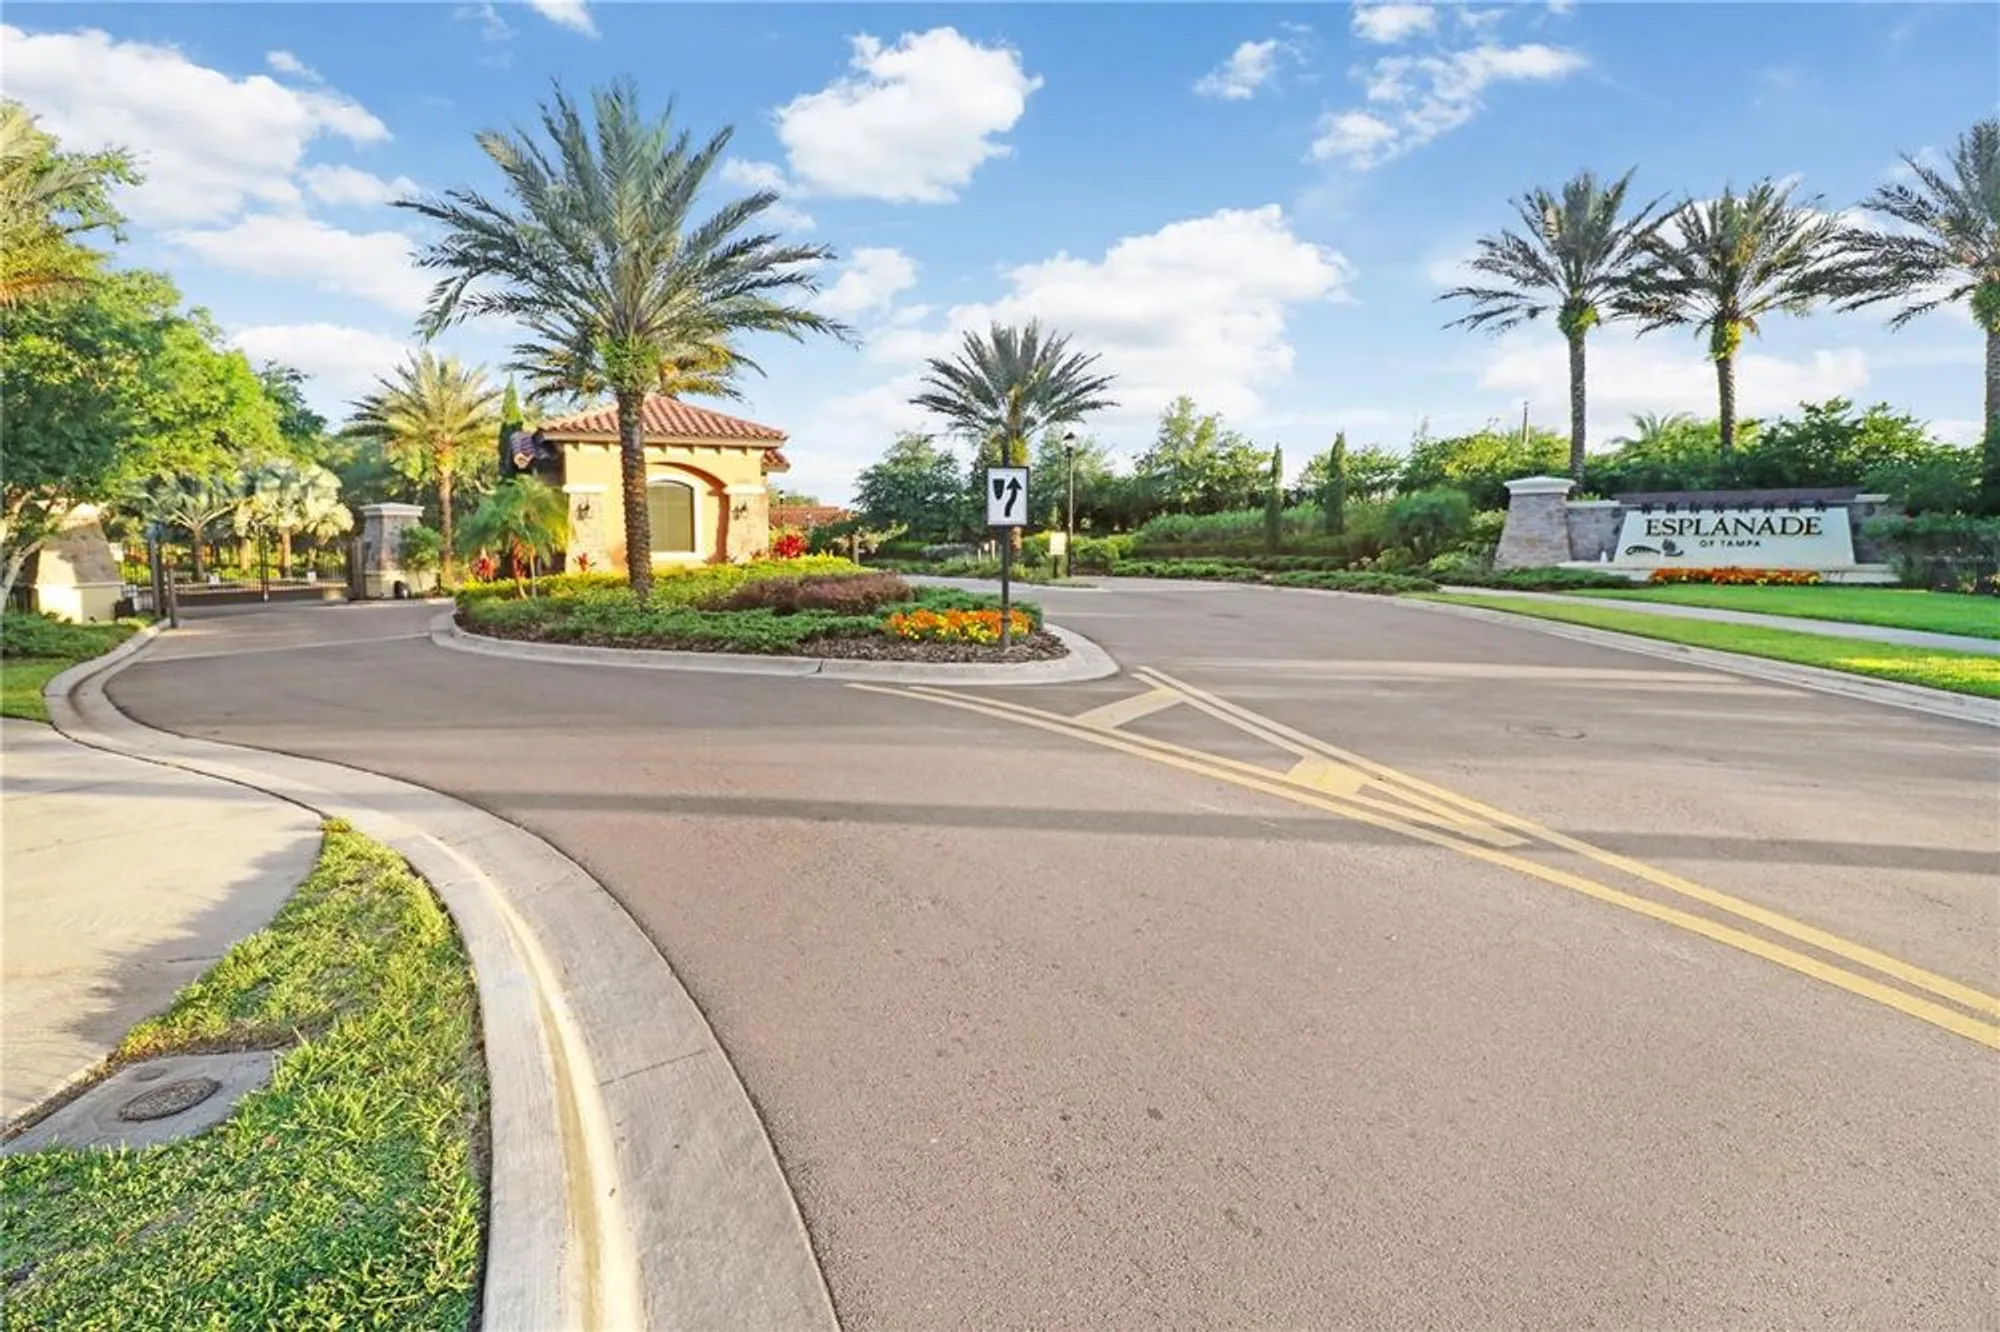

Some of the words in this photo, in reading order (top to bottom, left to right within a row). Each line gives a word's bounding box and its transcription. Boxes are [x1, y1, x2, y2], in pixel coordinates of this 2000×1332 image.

[1645, 516, 1823, 537] ESPLANADE
[1699, 540, 1713, 548] OF
[1720, 539, 1761, 548] TAMPA
